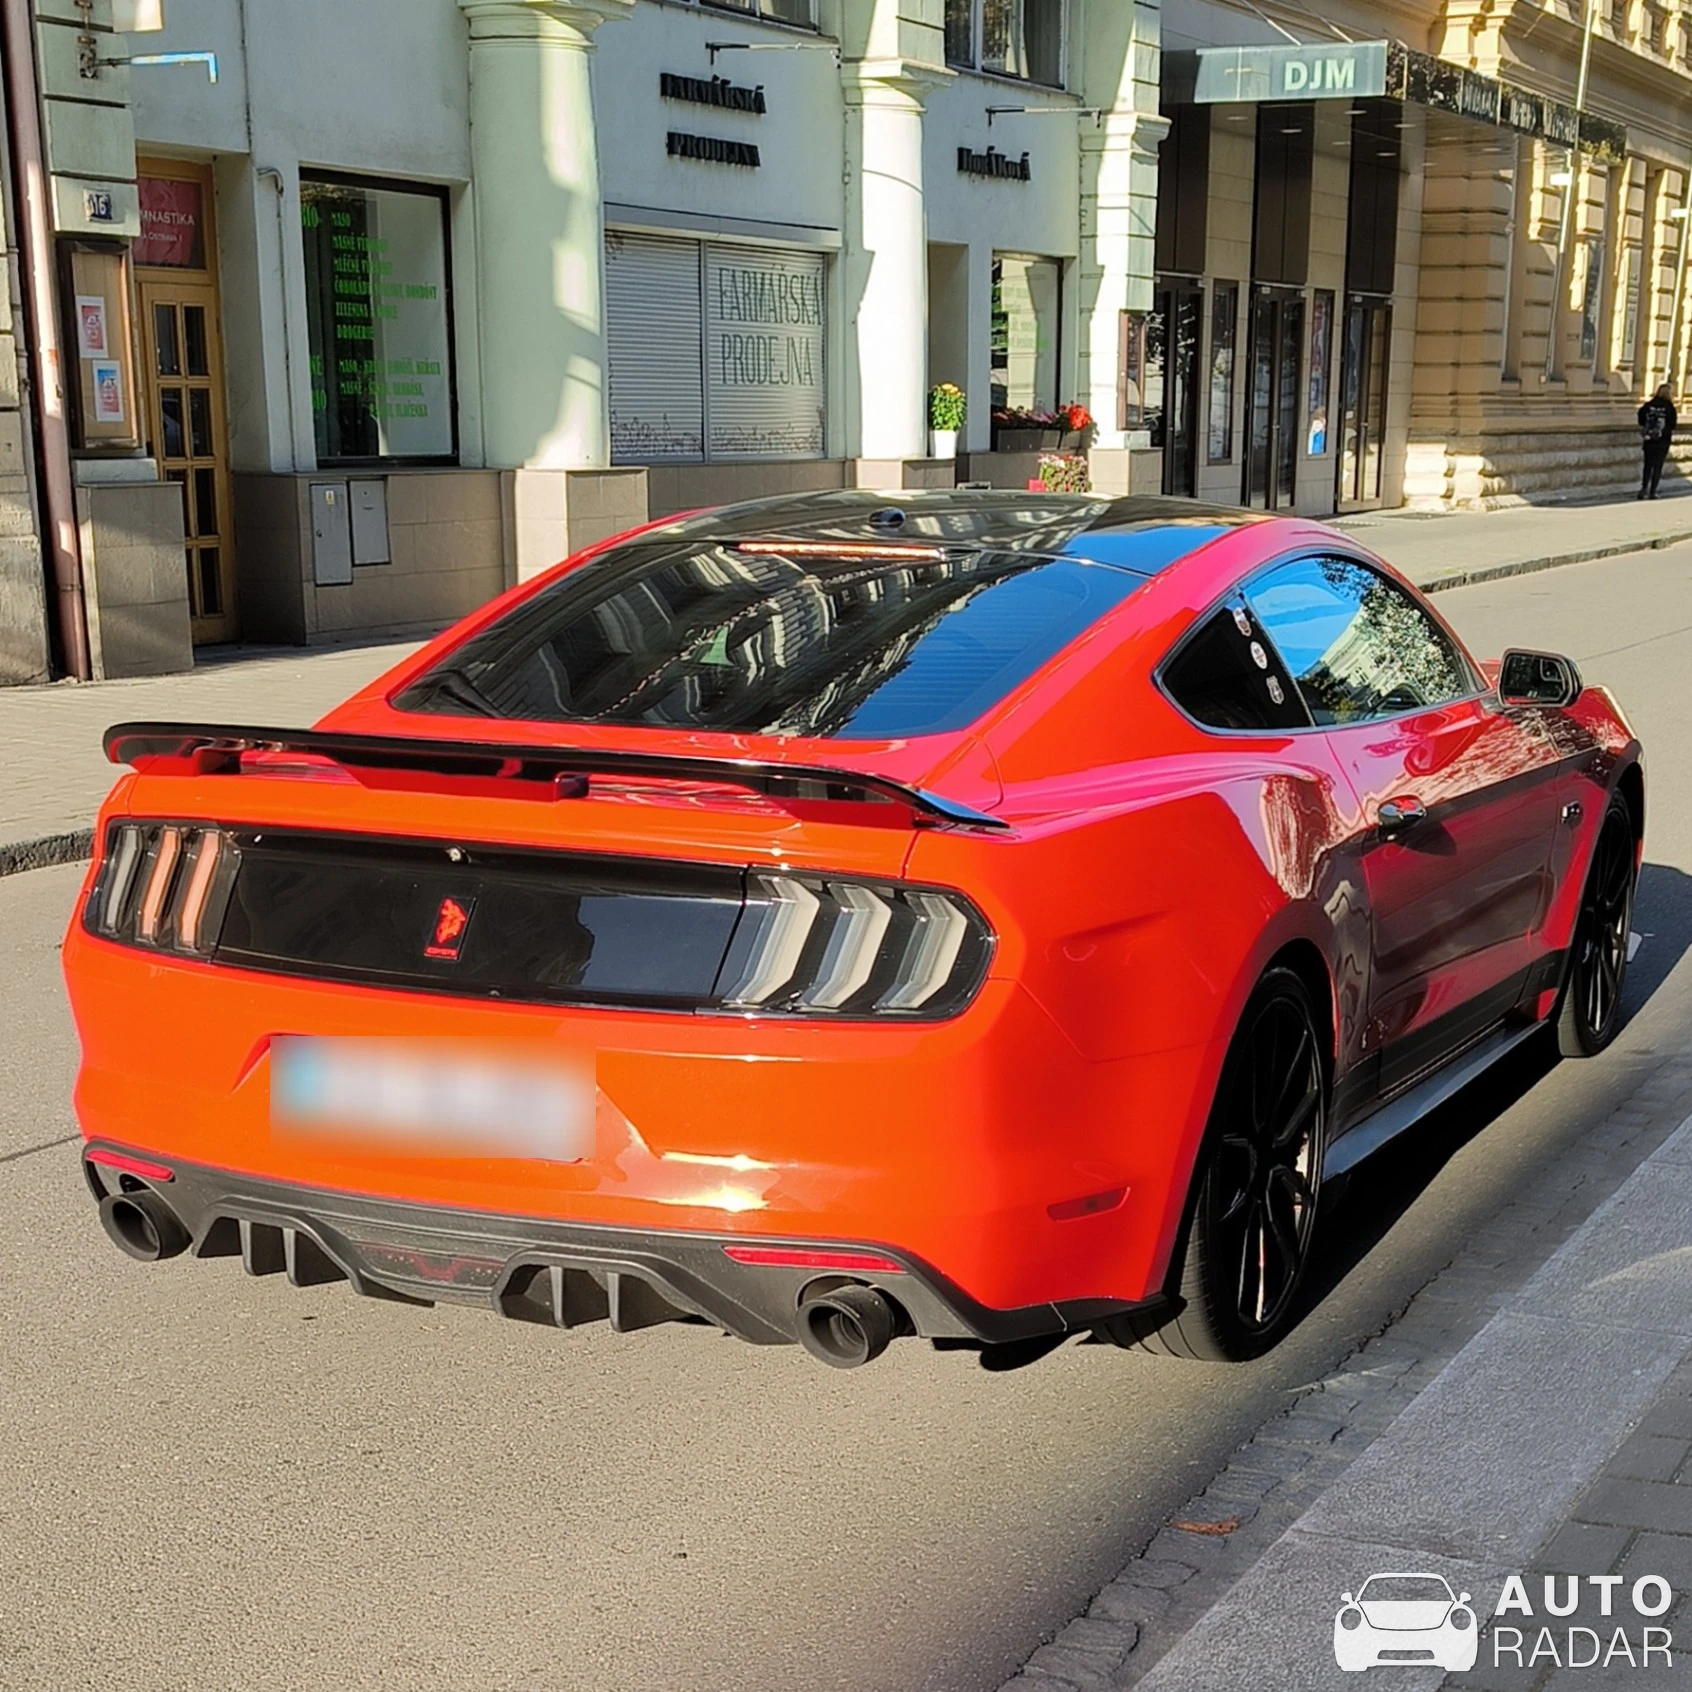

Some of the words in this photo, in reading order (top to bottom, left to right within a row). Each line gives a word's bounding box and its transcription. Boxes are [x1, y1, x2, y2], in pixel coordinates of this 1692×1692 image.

[660, 73, 766, 114] FARMÁŘSKÁ
[1284, 58, 1355, 91] DJM
[667, 131, 760, 167] PRODEJNA
[719, 264, 821, 325] FARMÁŘSKÁ
[722, 334, 813, 386] PRODEJNA
